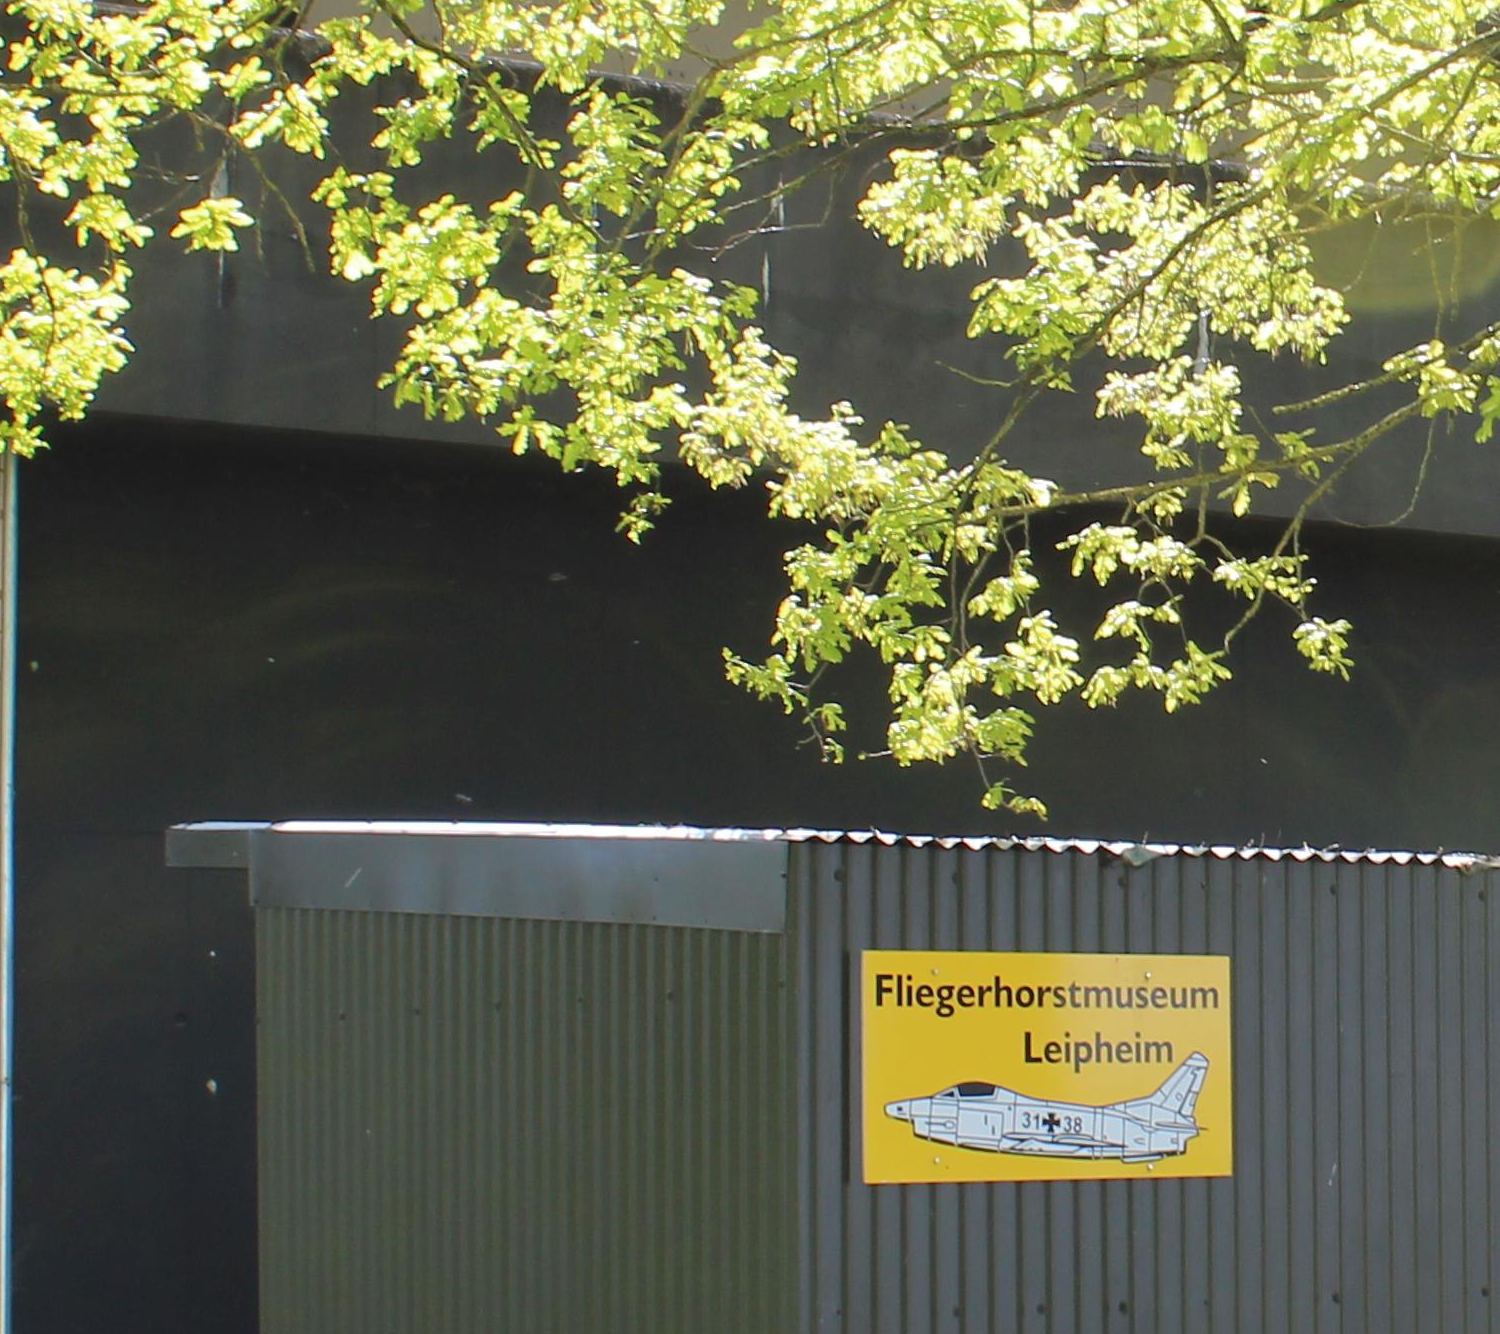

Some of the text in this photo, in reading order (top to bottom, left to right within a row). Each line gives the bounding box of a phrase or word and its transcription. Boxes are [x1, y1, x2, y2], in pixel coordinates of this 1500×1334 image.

[875, 974, 1219, 1017] Fliegerhorstmuseum
[1024, 1031, 1174, 1073] Leipheim
[1021, 1112, 1082, 1133] 31 38
